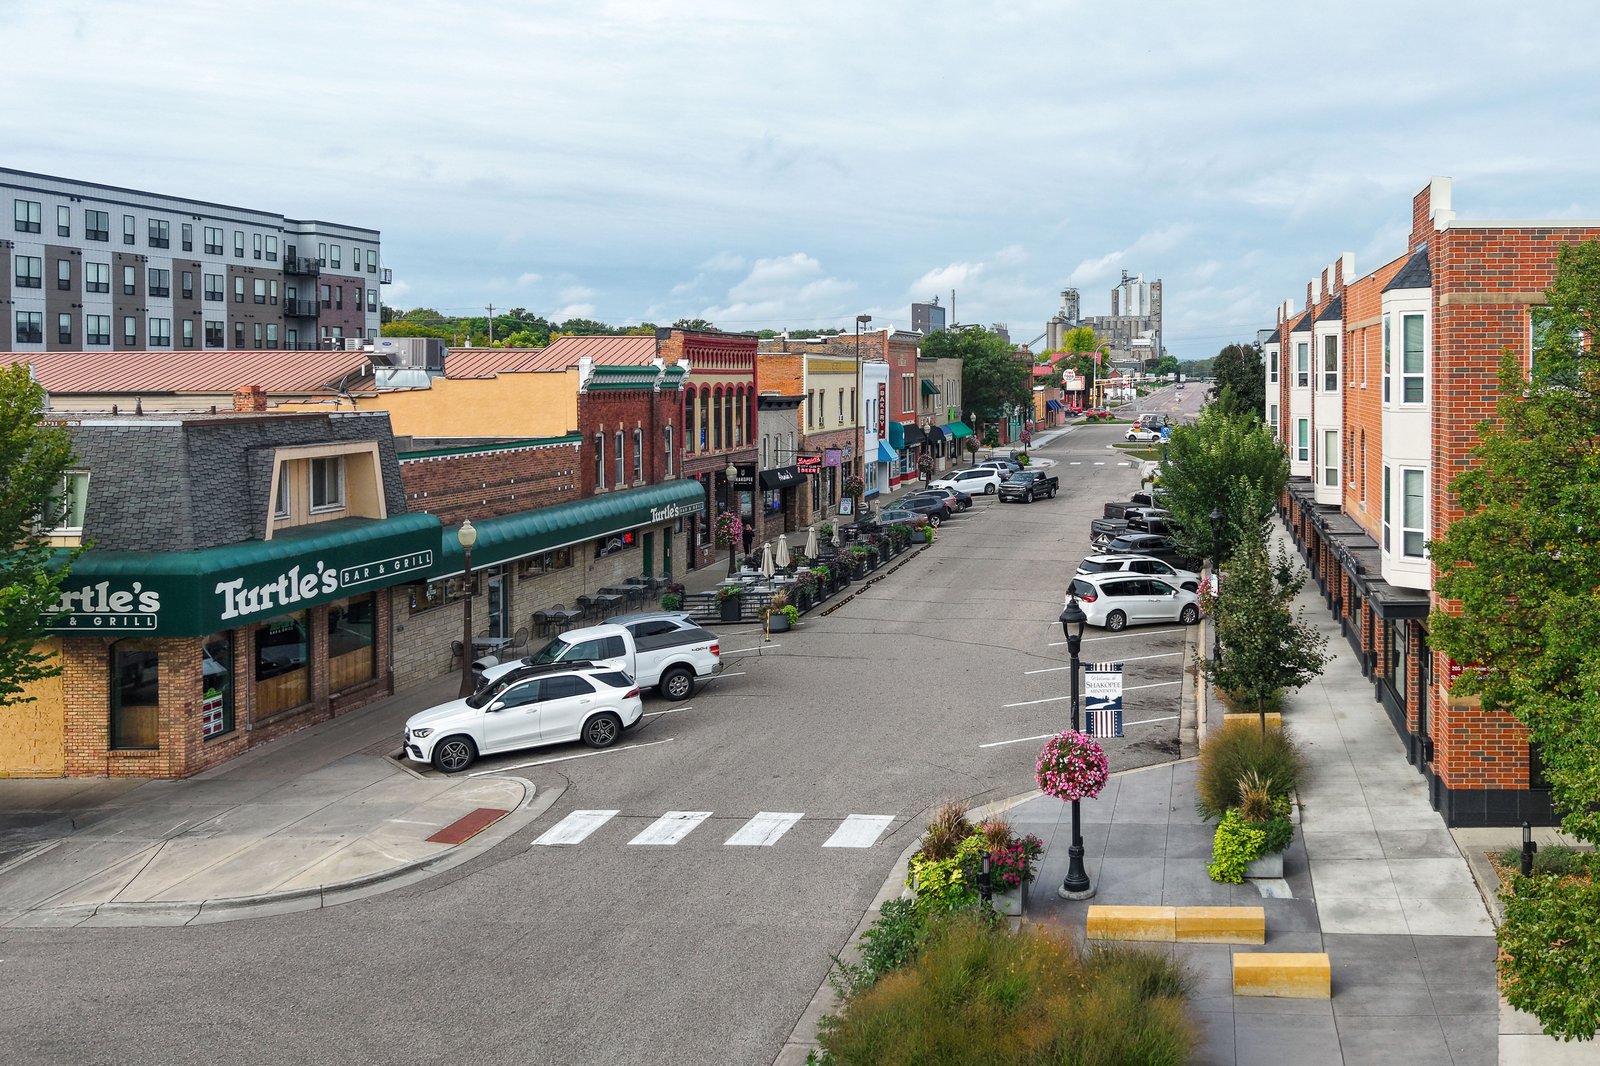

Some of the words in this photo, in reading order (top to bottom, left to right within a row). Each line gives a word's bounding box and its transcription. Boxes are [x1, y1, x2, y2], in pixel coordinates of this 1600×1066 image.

[650, 503, 680, 523] Turtle's
[344, 567, 370, 583] BAR
[379, 564, 385, 574] &
[394, 553, 430, 570] GRILL
[214, 560, 338, 620] Turtle's
[69, 616, 77, 626] &
[93, 616, 153, 626] GRILL
